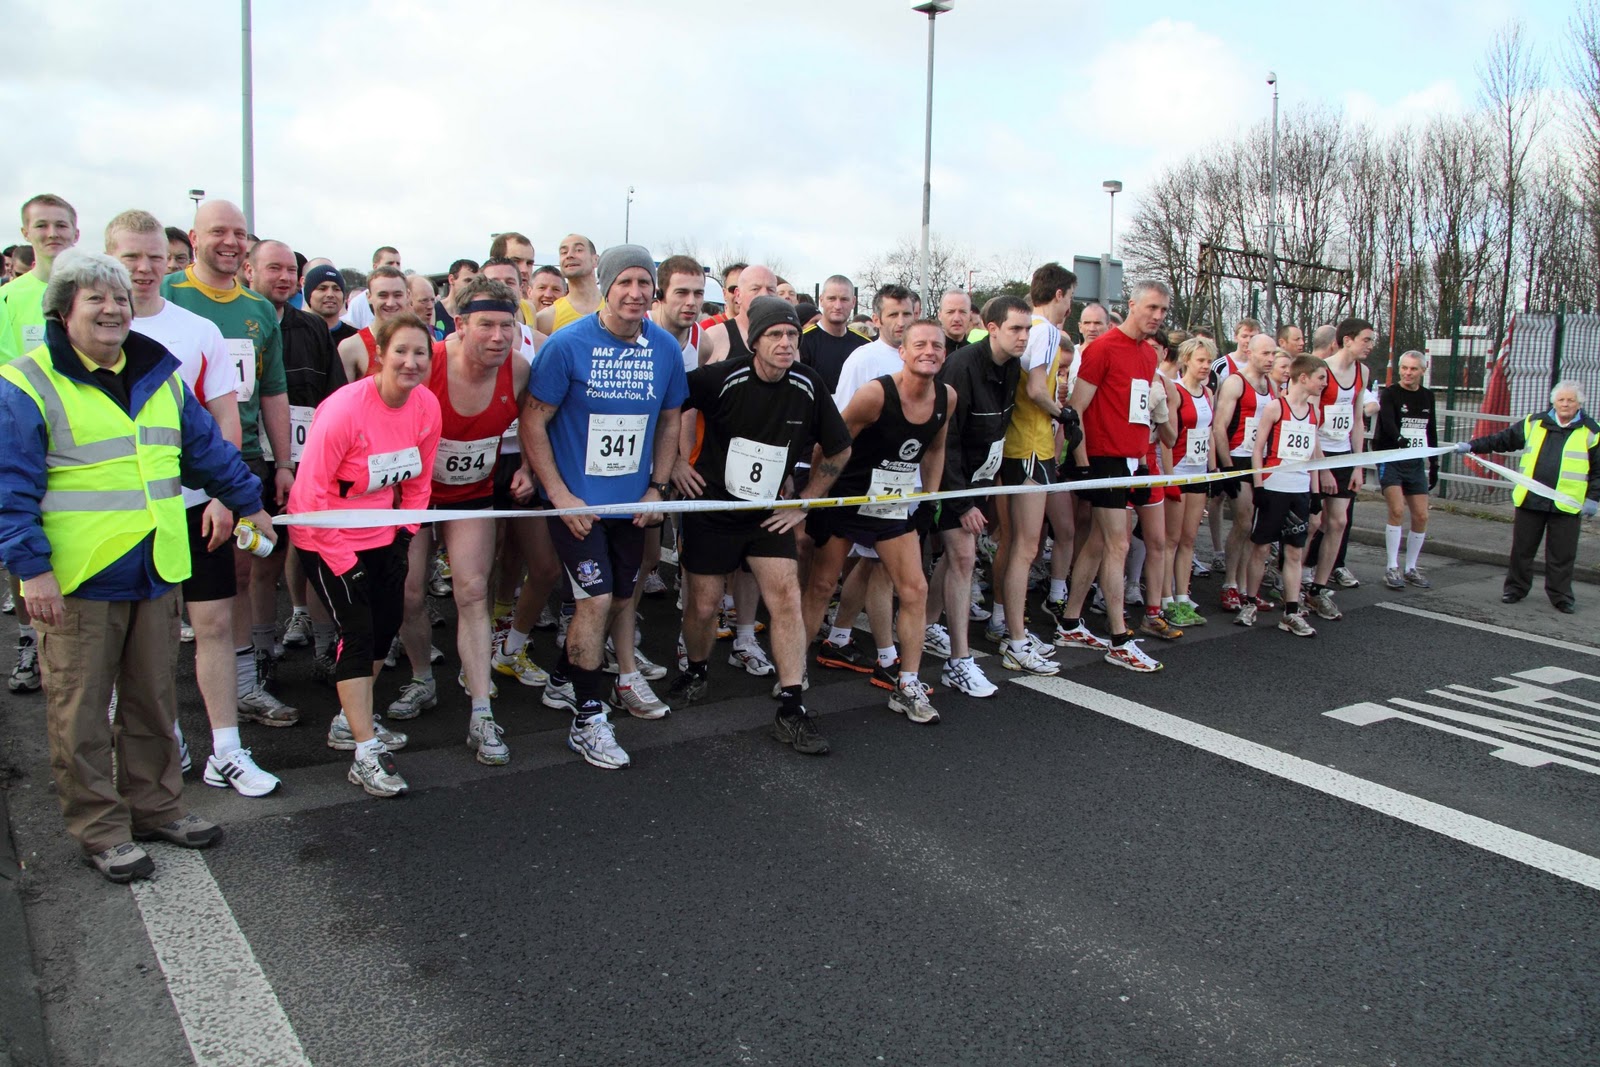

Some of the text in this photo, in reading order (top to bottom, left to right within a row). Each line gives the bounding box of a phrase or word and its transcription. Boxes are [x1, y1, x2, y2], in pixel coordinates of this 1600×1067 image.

[591, 359, 654, 371] TEAMWEAR
[590, 369, 654, 381] 0151 430 9898
[603, 379, 644, 389] everton
[586, 387, 644, 401] foundation.
[1332, 416, 1350, 430] 105
[600, 434, 636, 457] 341
[1194, 440, 1209, 455] 34
[1287, 433, 1310, 449] 288
[445, 452, 485, 472] 634
[750, 462, 763, 483] 8
